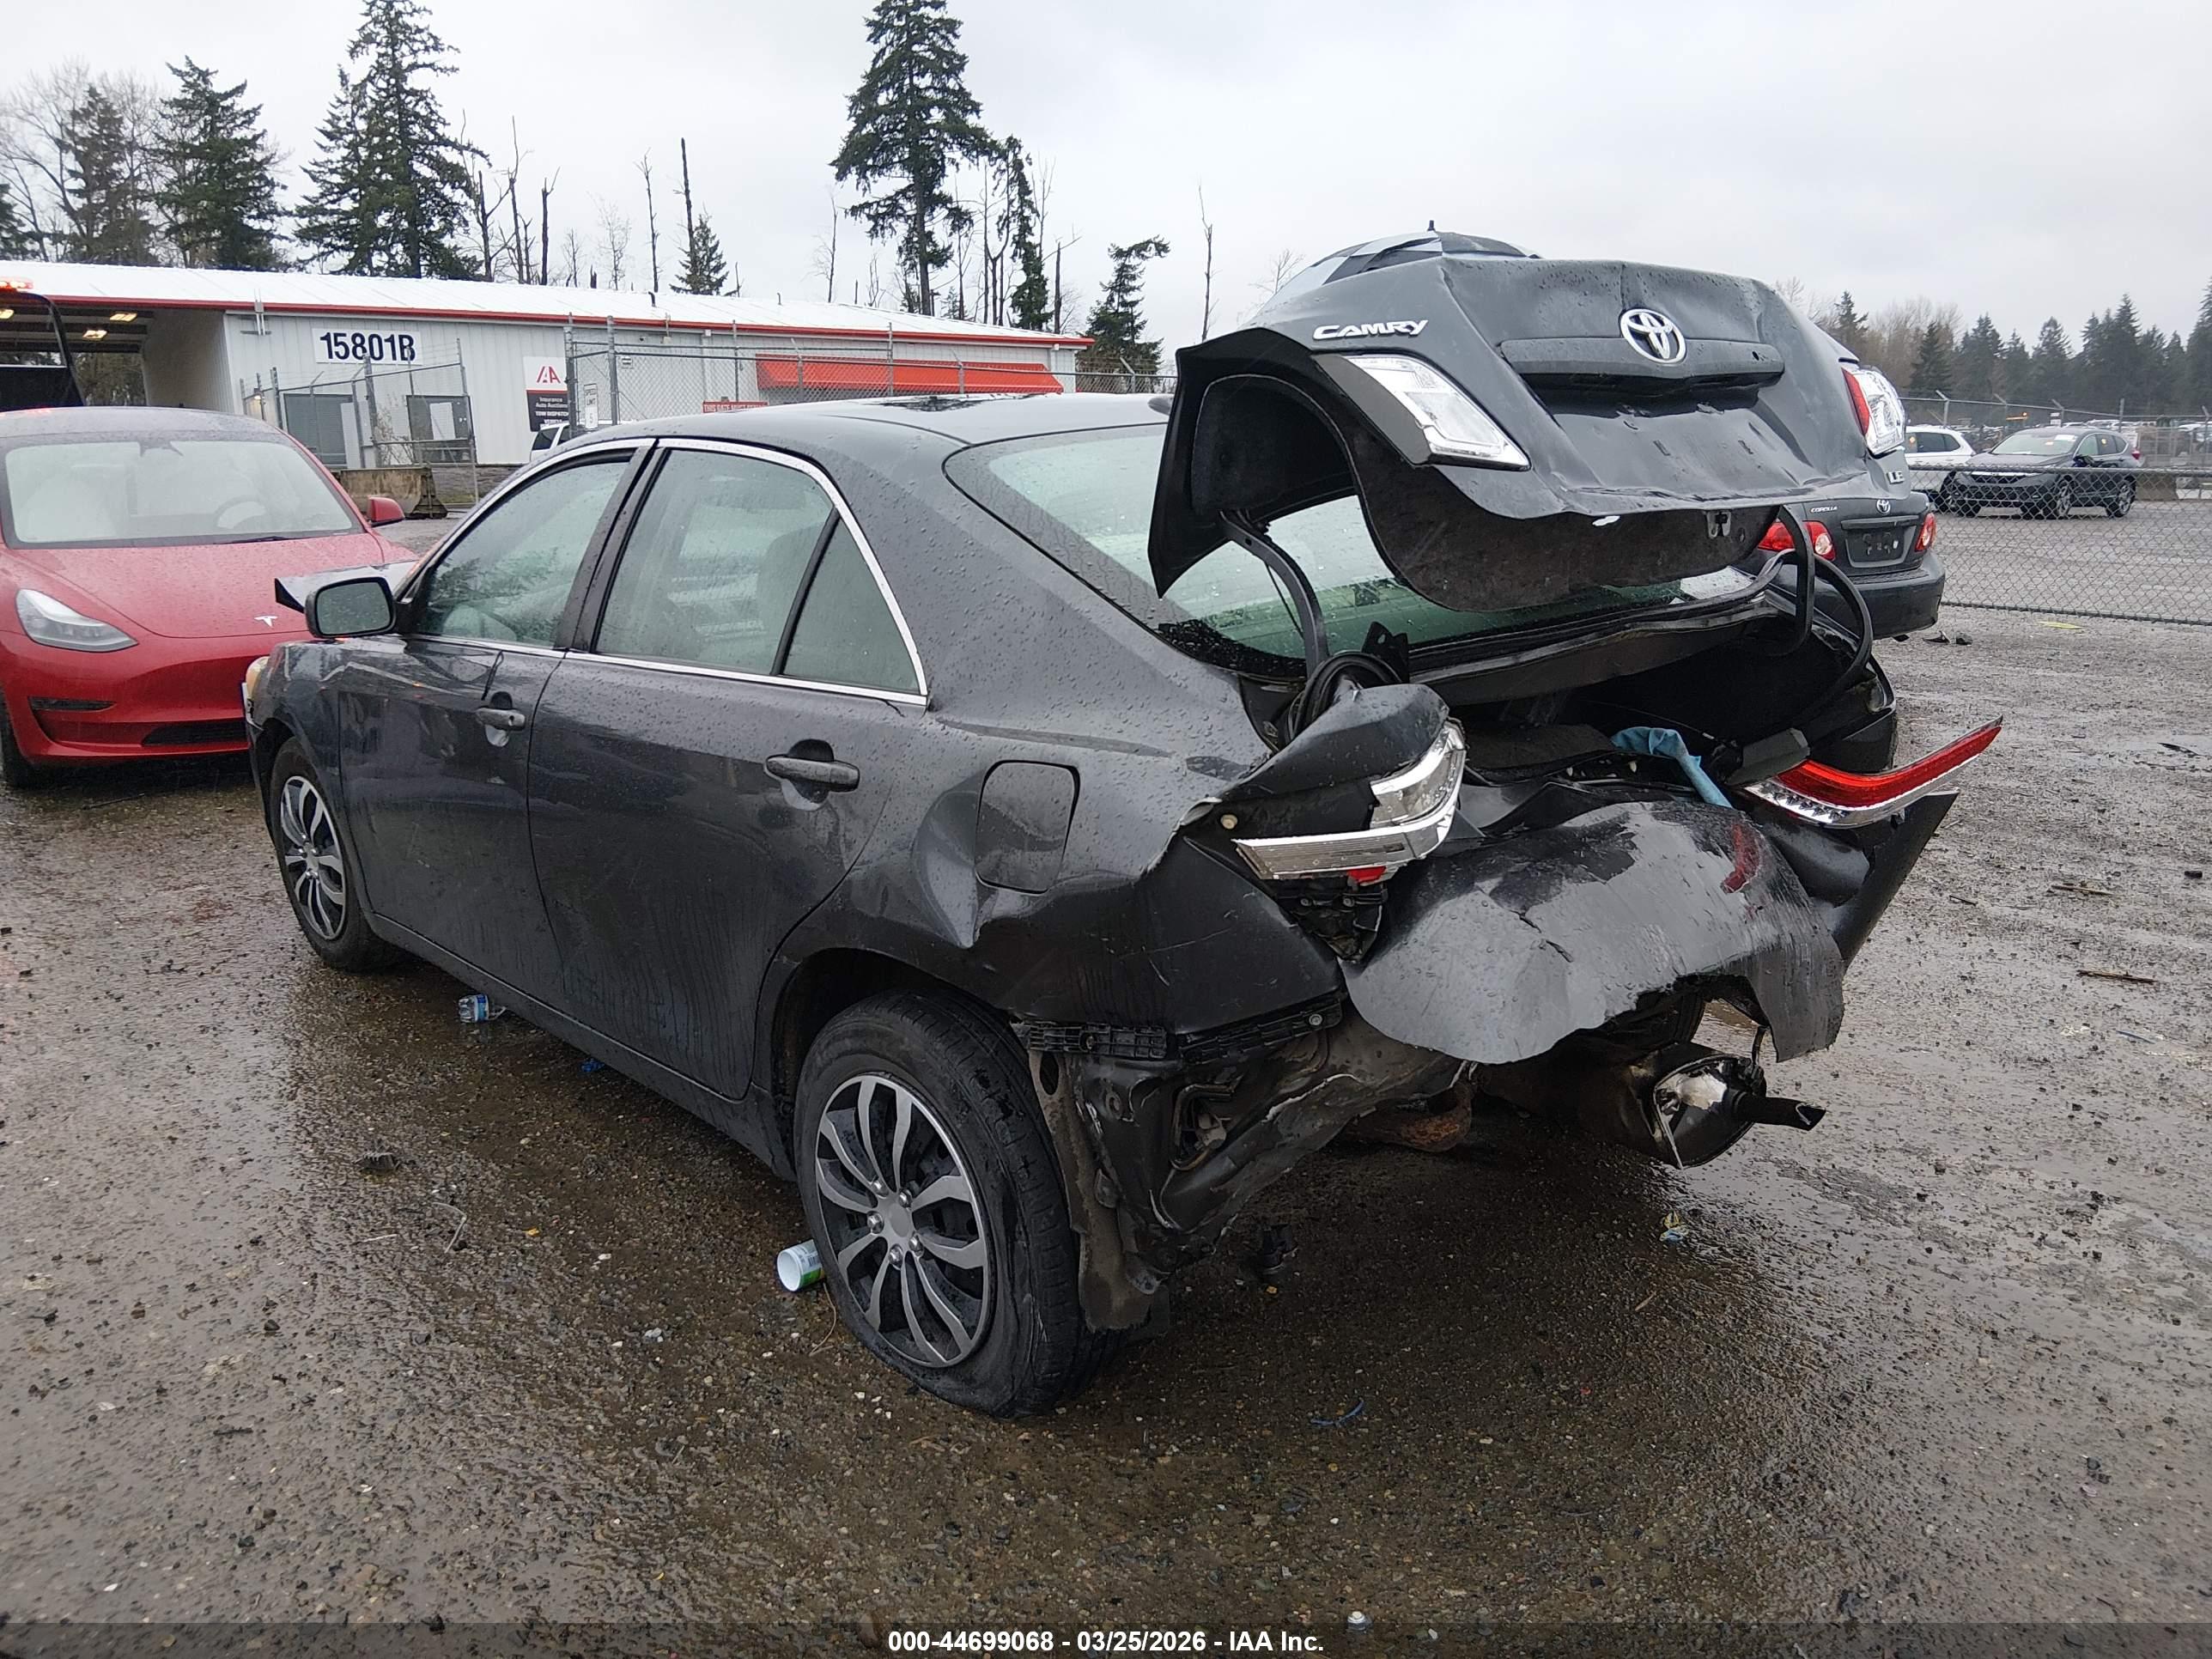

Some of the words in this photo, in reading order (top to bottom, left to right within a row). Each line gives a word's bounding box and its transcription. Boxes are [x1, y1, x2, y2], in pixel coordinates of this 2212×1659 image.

[1313, 319, 1428, 340] CAMRY
[319, 331, 416, 362] 15801B
[1889, 471, 1905, 483] LE
